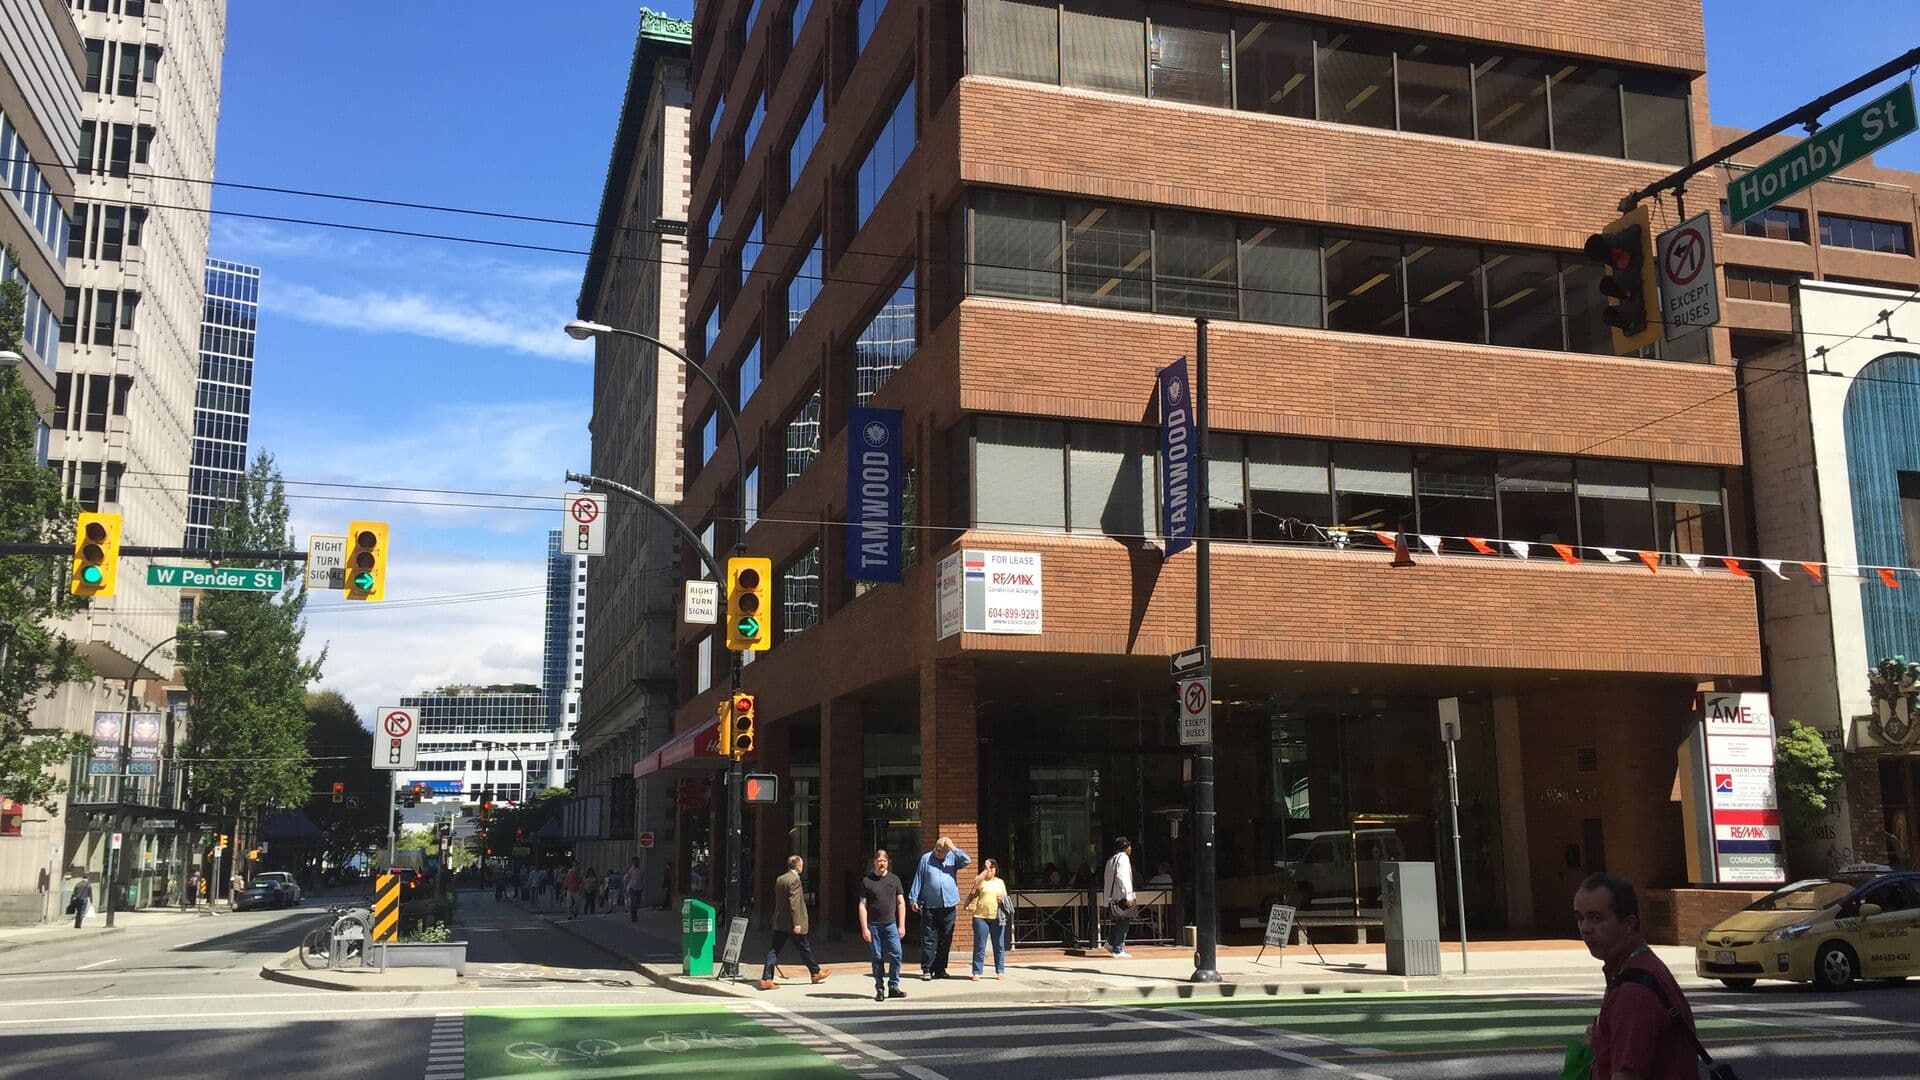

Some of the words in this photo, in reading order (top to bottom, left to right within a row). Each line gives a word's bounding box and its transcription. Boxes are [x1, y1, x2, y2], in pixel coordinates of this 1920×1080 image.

[1740, 133, 1845, 209] Hornby
[1861, 100, 1899, 142] St
[1670, 283, 1709, 311] EXCEPT
[1674, 302, 1710, 327] BUSES
[1168, 408, 1188, 541] TAMWOOD
[861, 451, 890, 568] TAMWOOD
[314, 541, 343, 552] RIGHT
[316, 555, 340, 566] TURN
[991, 555, 1008, 564] FOR
[1009, 556, 1034, 566] LEASE
[157, 569, 174, 584] W
[182, 571, 246, 586] Pender
[253, 573, 274, 588] St
[310, 570, 343, 581] SIGNAL
[992, 573, 1035, 586] RE/MAX
[690, 587, 713, 595] RIGHT
[691, 597, 713, 605] TURN
[688, 607, 713, 616] SIGNAL
[1184, 718, 1207, 728] EXCEPT
[1185, 728, 1206, 737] BUSES
[1730, 826, 1766, 839] RE/MAX
[1729, 856, 1773, 864] COMMERCIAL
